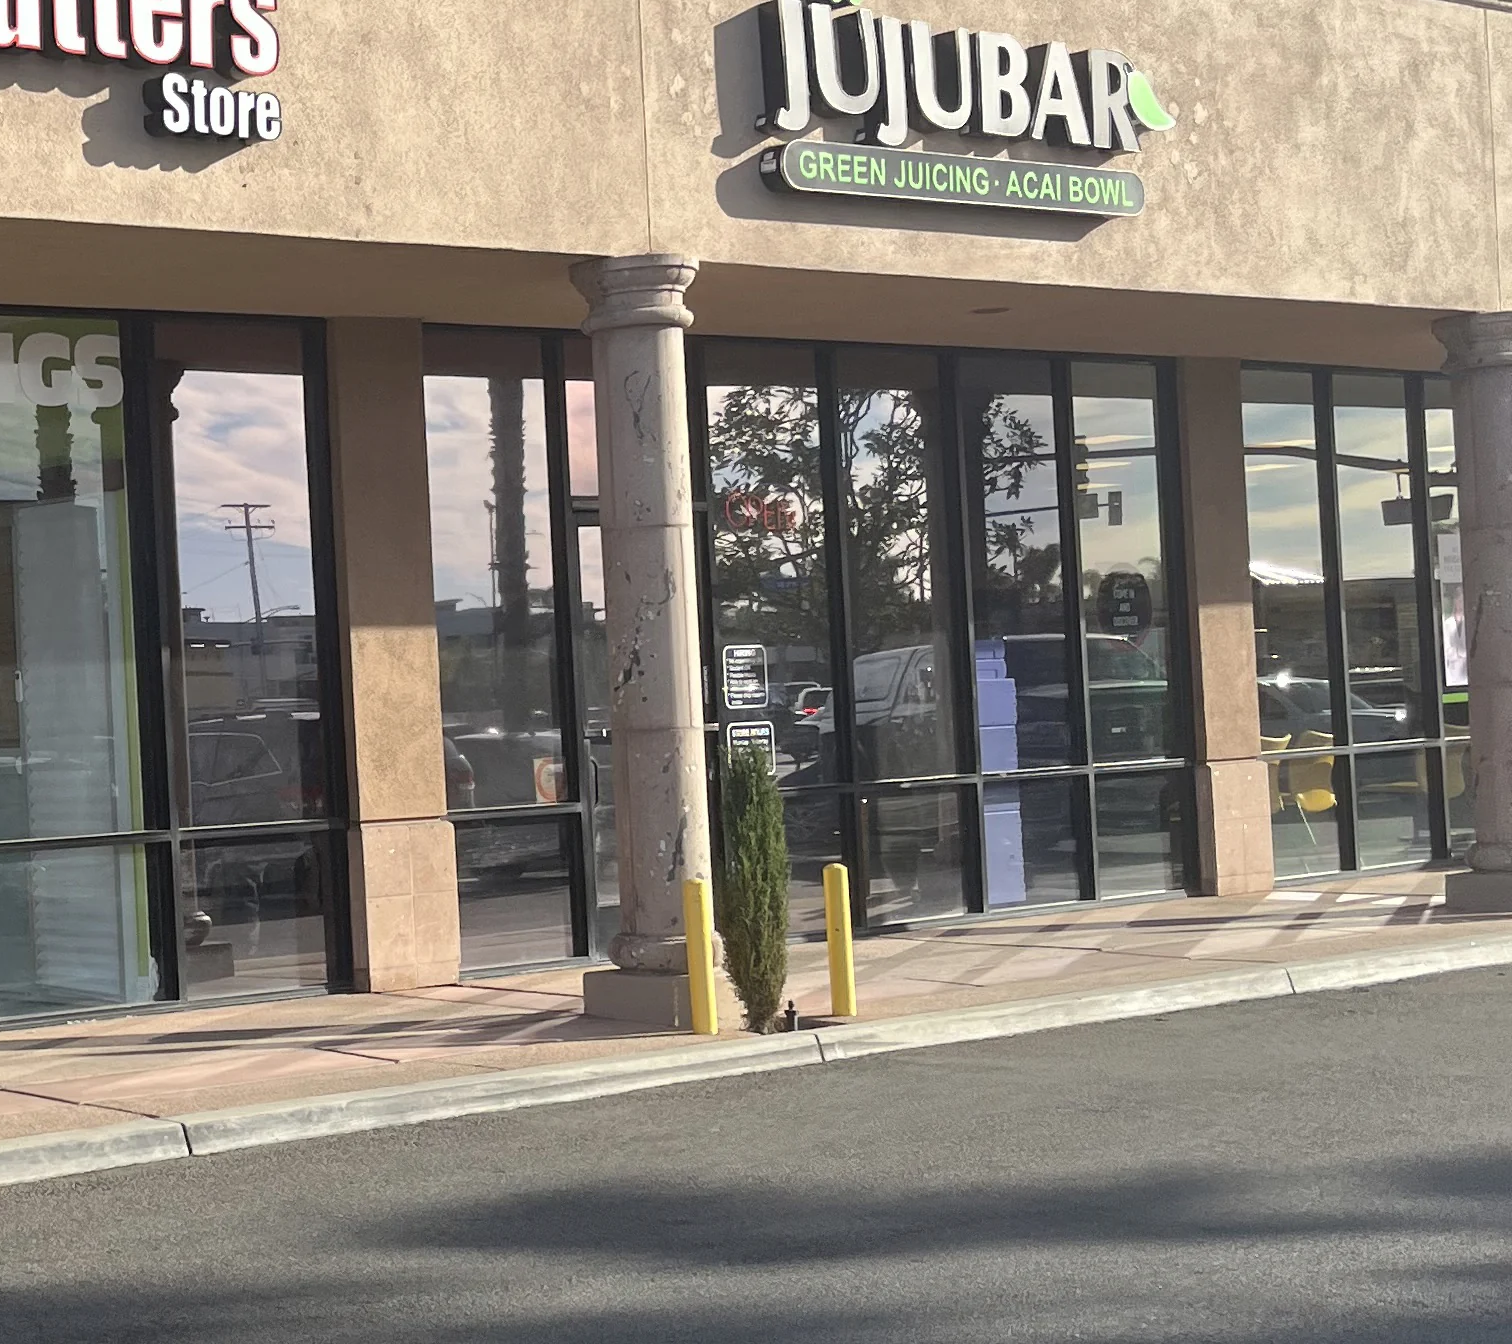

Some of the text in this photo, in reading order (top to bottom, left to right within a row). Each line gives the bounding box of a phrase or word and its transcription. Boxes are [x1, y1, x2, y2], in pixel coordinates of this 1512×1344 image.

[162, 72, 281, 140] Store
[799, 150, 1134, 207] GREEN JUICING ACAI BOWL
